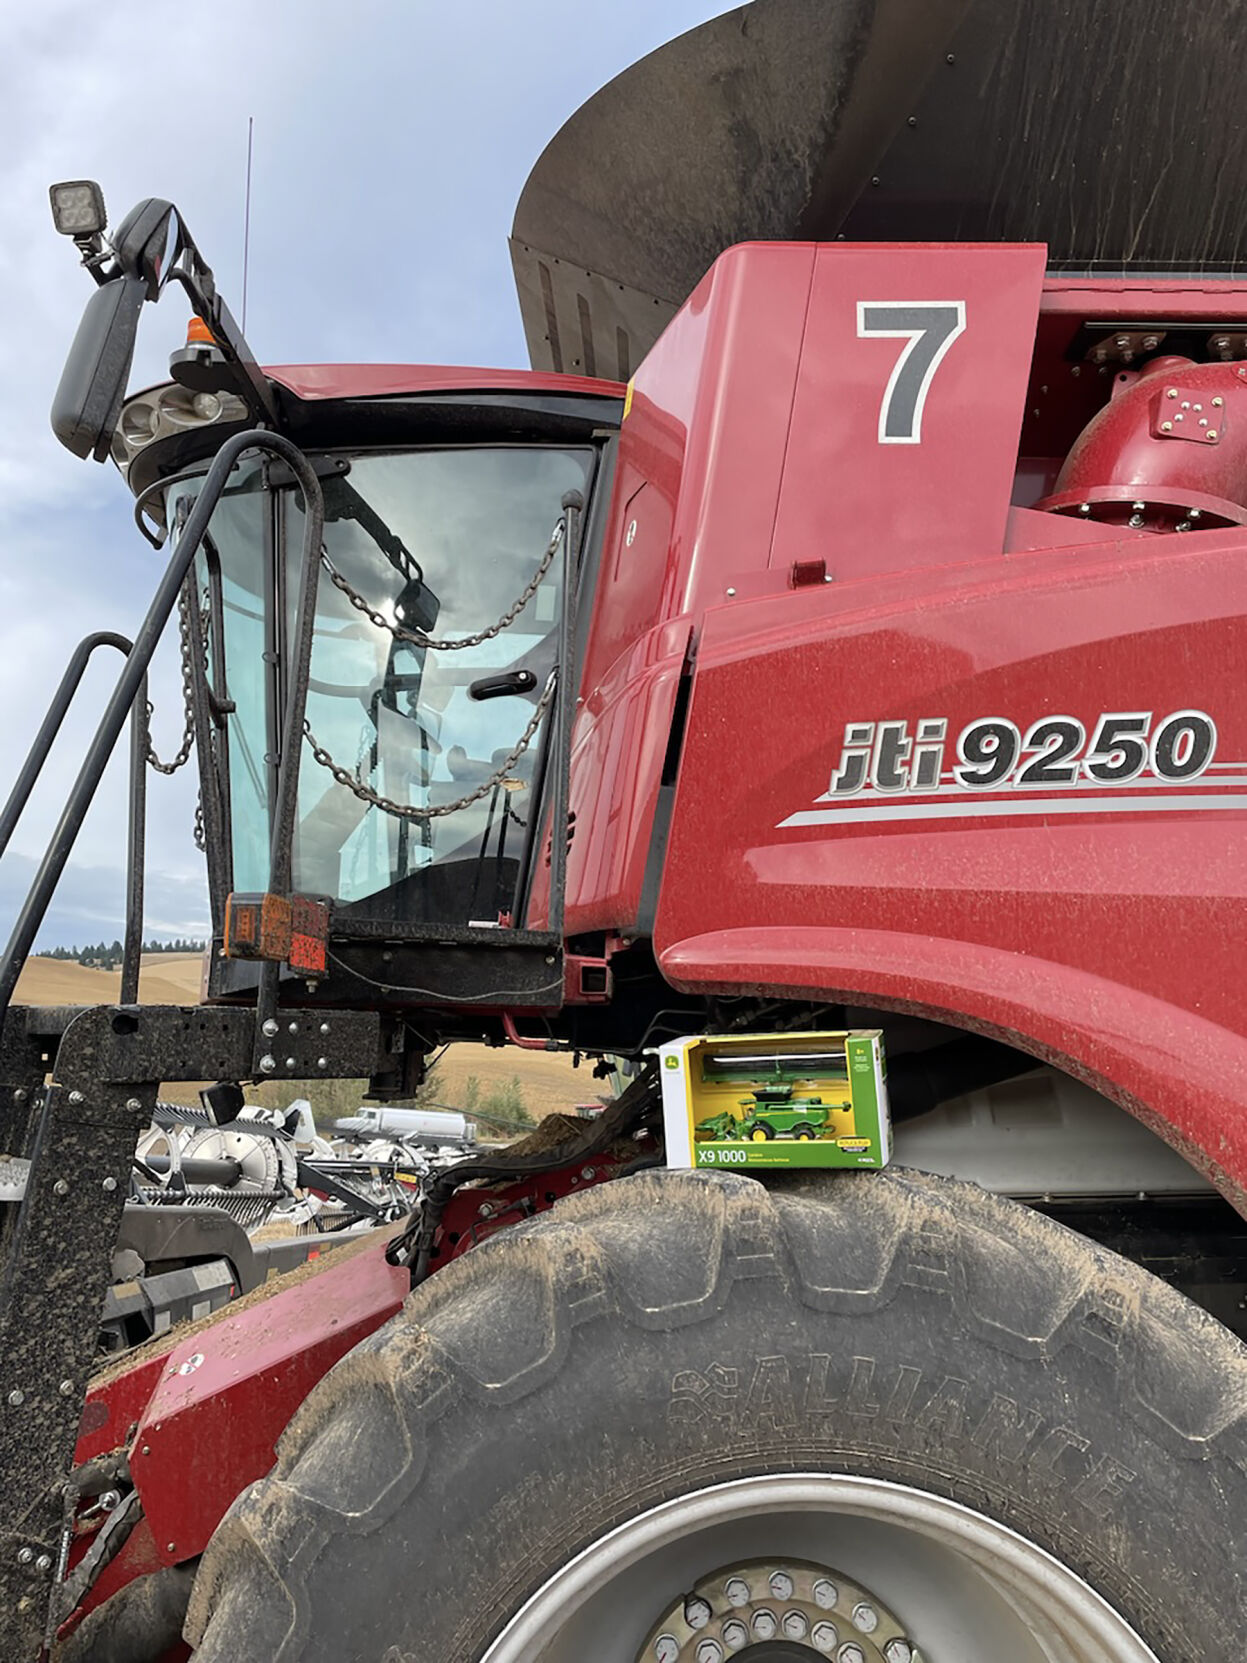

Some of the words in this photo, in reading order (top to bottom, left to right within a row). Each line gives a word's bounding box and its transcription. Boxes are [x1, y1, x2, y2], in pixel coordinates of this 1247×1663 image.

[856, 300, 966, 444] 7
[953, 709, 1217, 790] 9250
[698, 1150, 715, 1163] X9
[717, 1150, 747, 1163] 1000
[737, 1354, 1137, 1519] ALLIANCE
